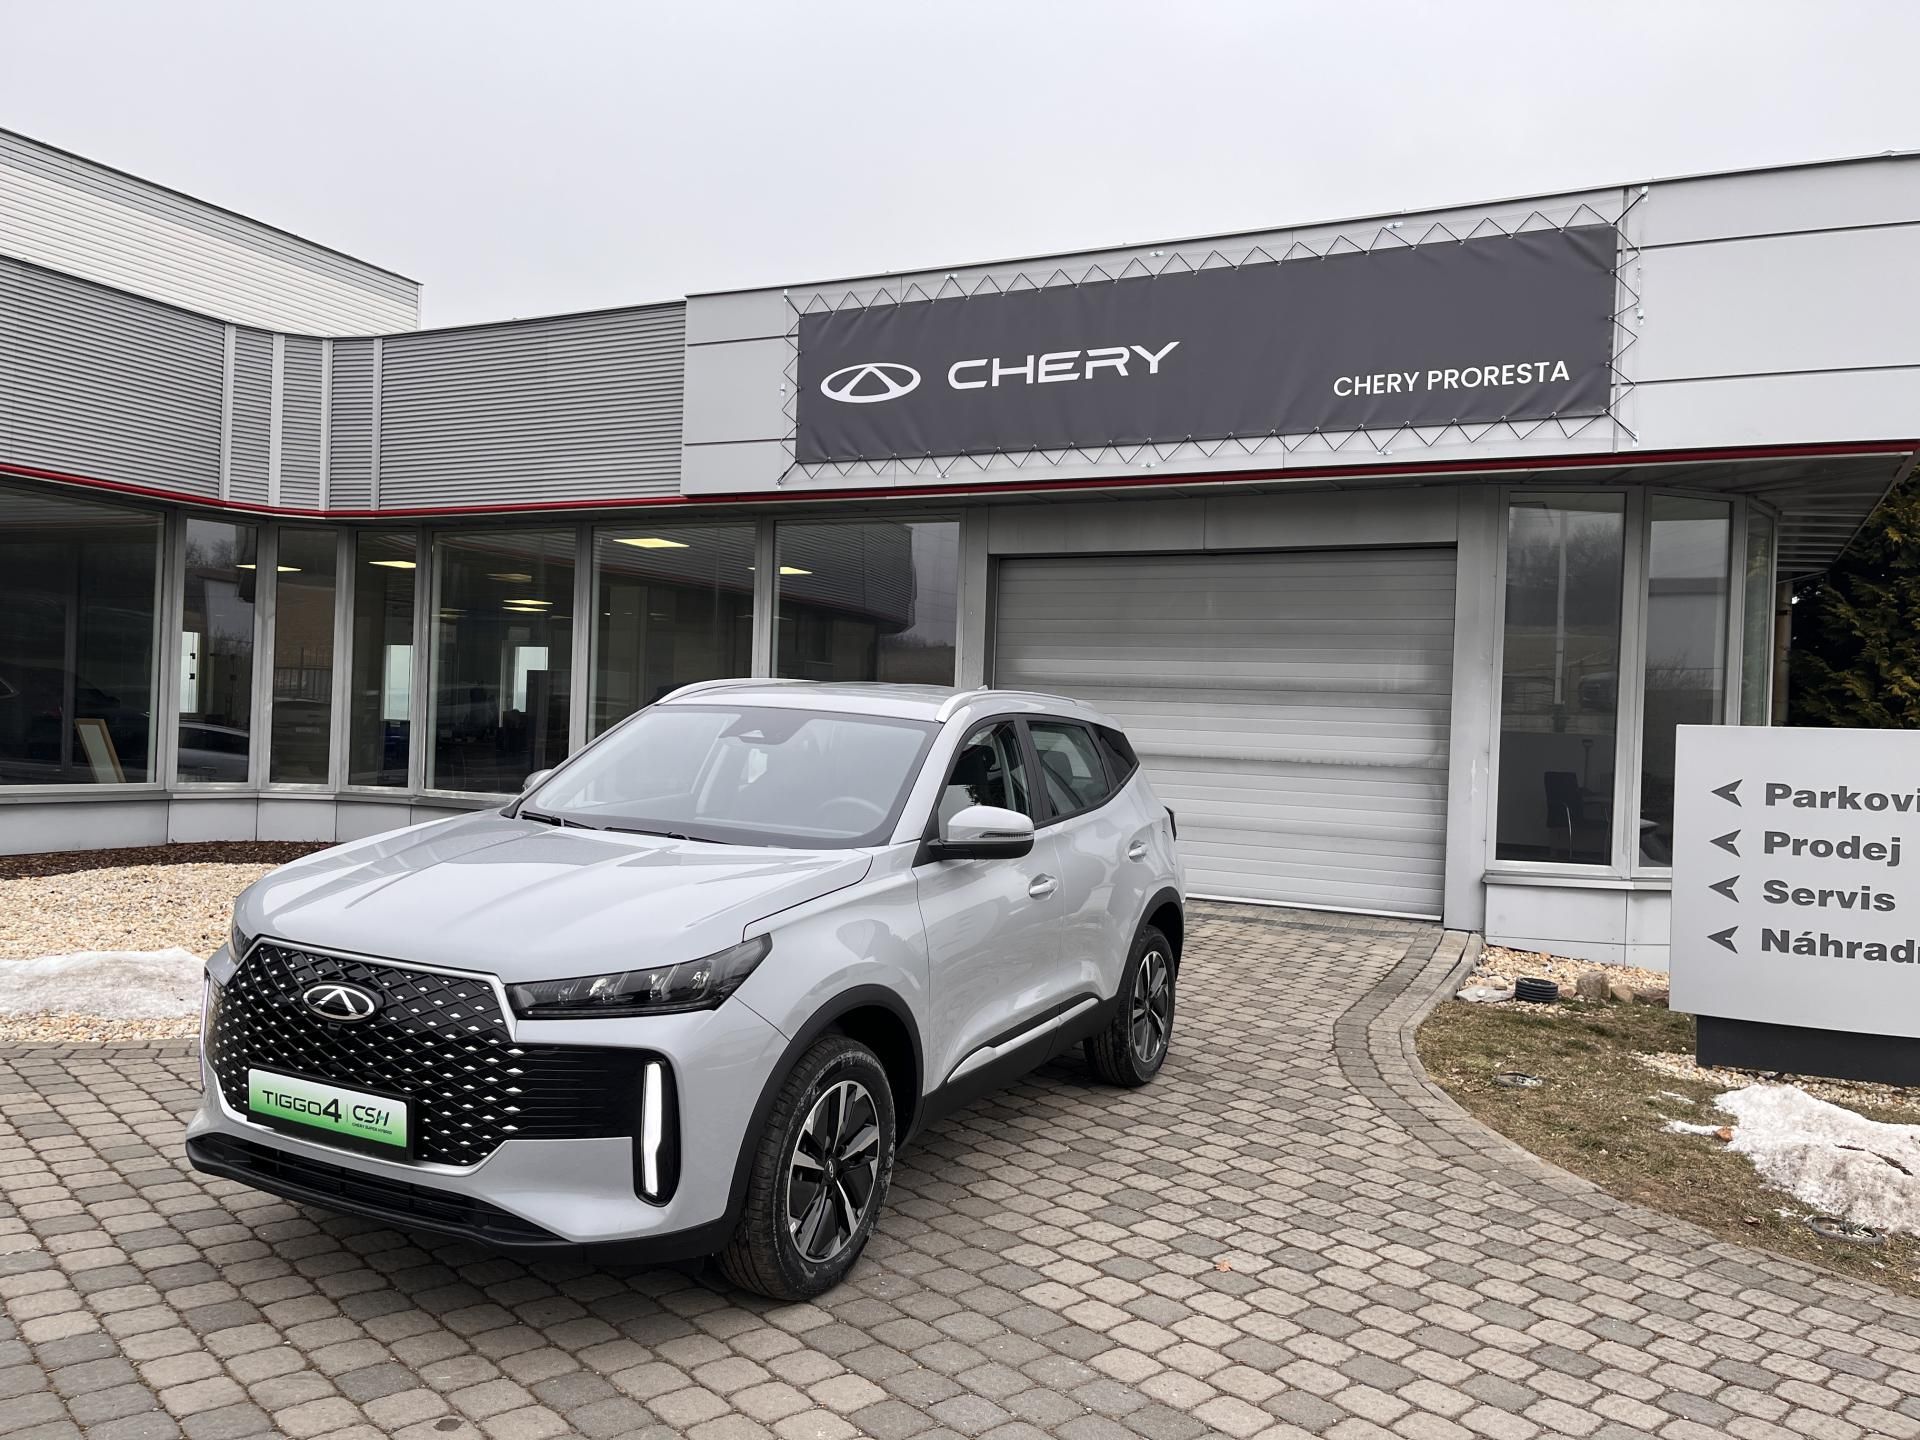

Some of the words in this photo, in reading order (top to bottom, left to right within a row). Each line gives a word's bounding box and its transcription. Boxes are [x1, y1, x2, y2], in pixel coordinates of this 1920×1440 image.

[947, 341, 1180, 391] CHERY
[1333, 369, 1420, 397] CHERY
[1427, 360, 1570, 392] PRORESTA
[1763, 830, 1901, 868] Prodej
[1762, 879, 1896, 912] Servis
[1761, 927, 1920, 965] Náhrad
[352, 1104, 390, 1126] CSH
